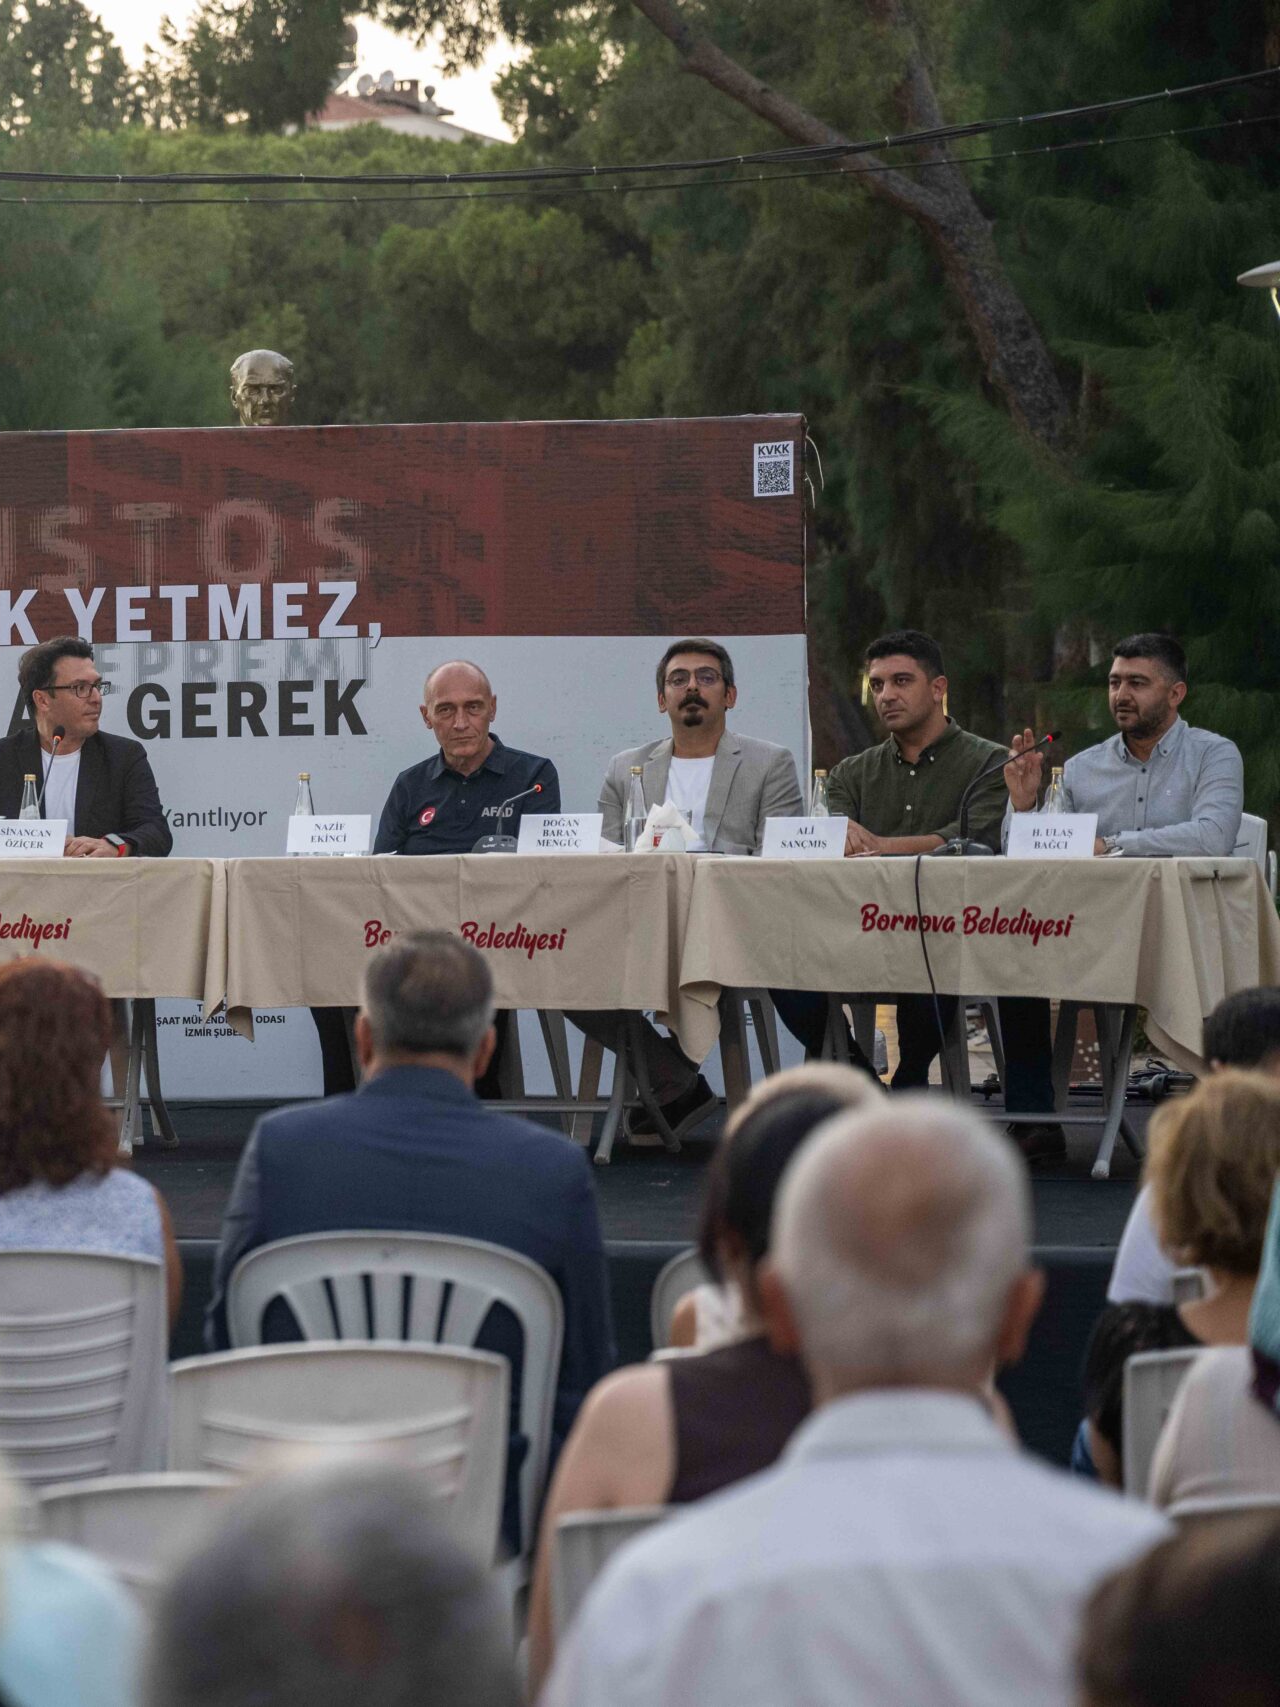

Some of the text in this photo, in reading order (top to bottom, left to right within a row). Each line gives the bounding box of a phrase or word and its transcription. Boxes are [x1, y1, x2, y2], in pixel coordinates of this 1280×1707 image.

[758, 443, 790, 455] KVKK
[63, 580, 382, 648] YETMEZ,
[126, 678, 369, 740] GEREK
[481, 805, 514, 818] AFAD
[314, 821, 346, 832] NAZİF
[542, 817, 580, 828] DOĞAN
[0, 826, 52, 838] SİNANCAN
[542, 828, 578, 838] BARAN
[796, 825, 815, 836] ALİ
[1032, 828, 1073, 838] H. ULAŞ
[5, 837, 44, 850] ÖZİÇER
[310, 832, 347, 844] EKİNCİ
[536, 837, 582, 849] MENGÜÇ
[780, 838, 827, 850] SANÇMIŞ
[1033, 838, 1068, 850] BAĞCI
[860, 903, 1074, 947] Bornova Belediyesi
[460, 921, 567, 960] Belediyesi
[156, 1016, 181, 1027] ŞAAT
[255, 1015, 286, 1024] ODASI
[184, 1026, 243, 1040] İZMİR ŞUBE
